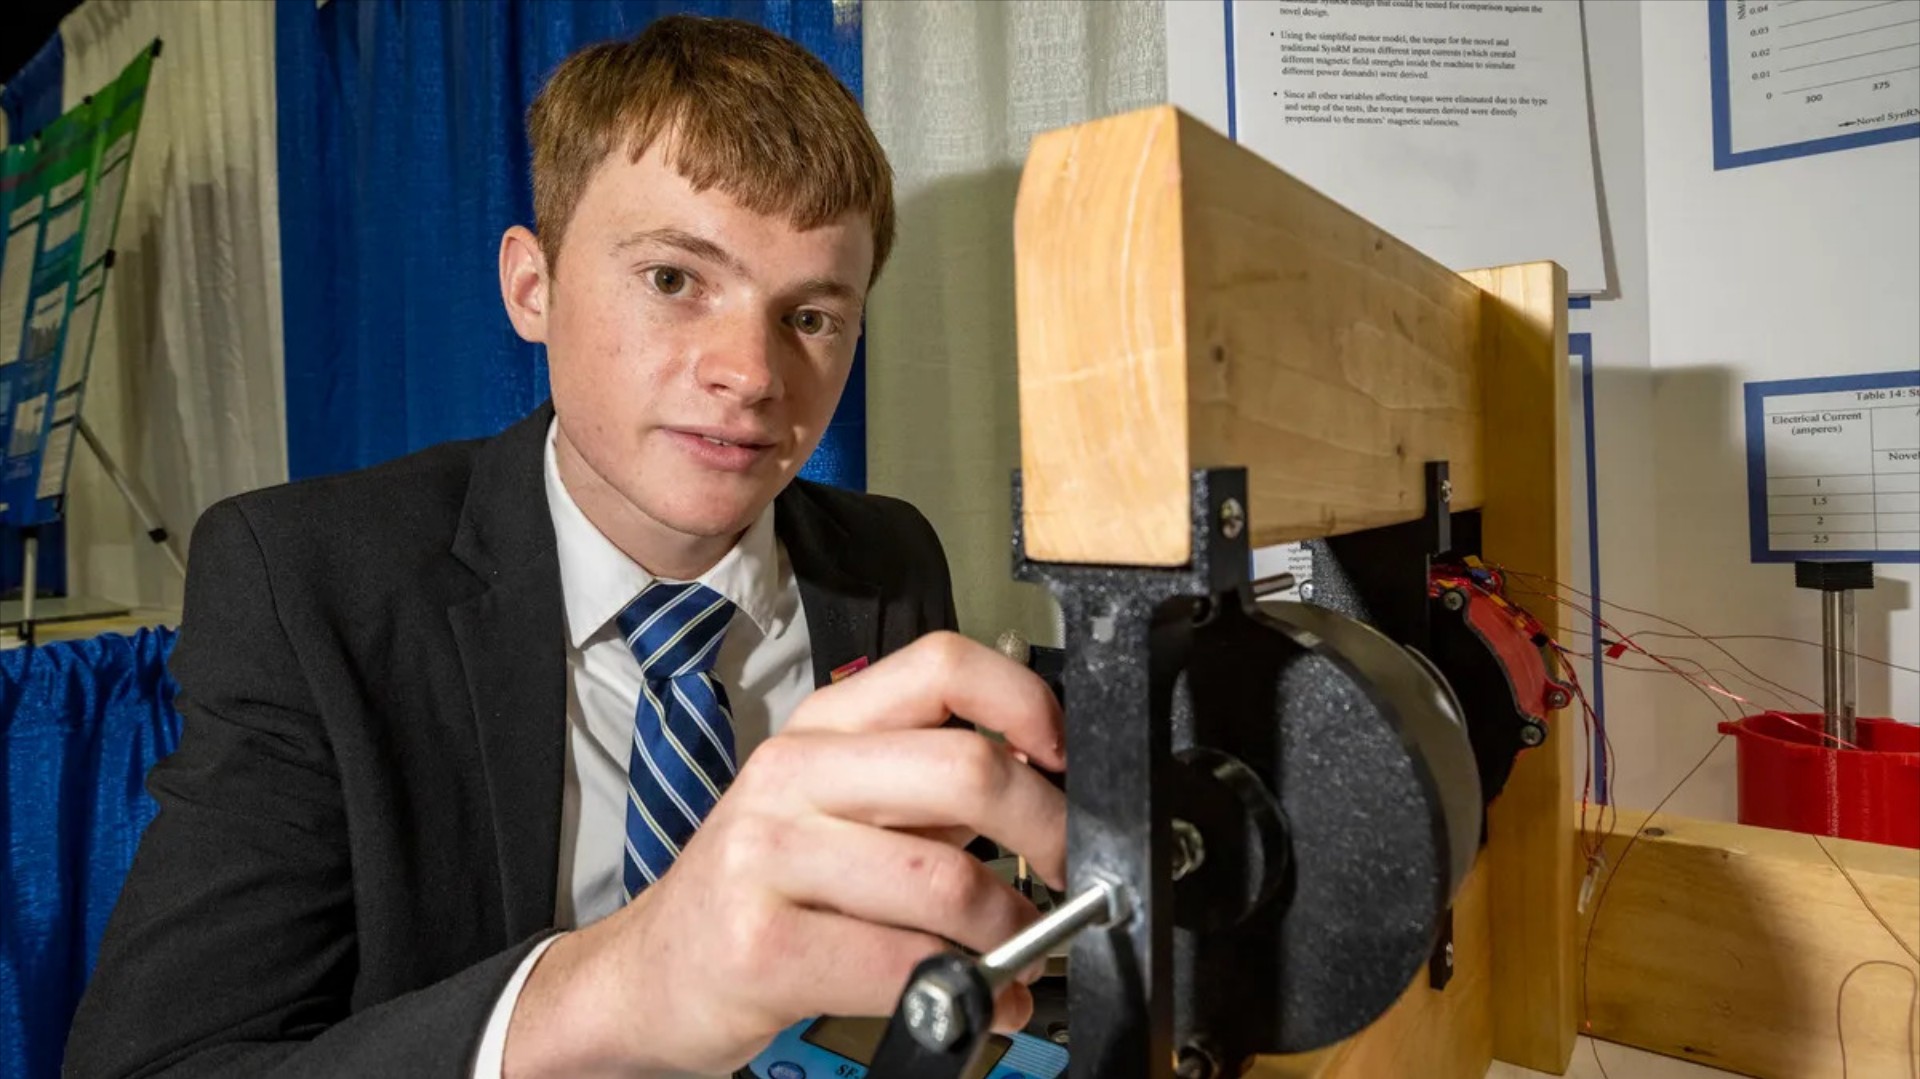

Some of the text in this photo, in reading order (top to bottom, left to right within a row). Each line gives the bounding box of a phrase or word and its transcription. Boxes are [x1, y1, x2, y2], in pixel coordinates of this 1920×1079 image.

[1766, 92, 1772, 100] 0
[1856, 391, 1885, 401] Table
[1890, 390, 1906, 399] 14:
[1772, 412, 1862, 425] Electrical Current
[1791, 425, 1843, 436] (amperes)
[1816, 478, 1821, 487] 1
[1812, 497, 1828, 506] 1.5
[1817, 516, 1824, 526] 2
[1813, 535, 1829, 544] 2.5
